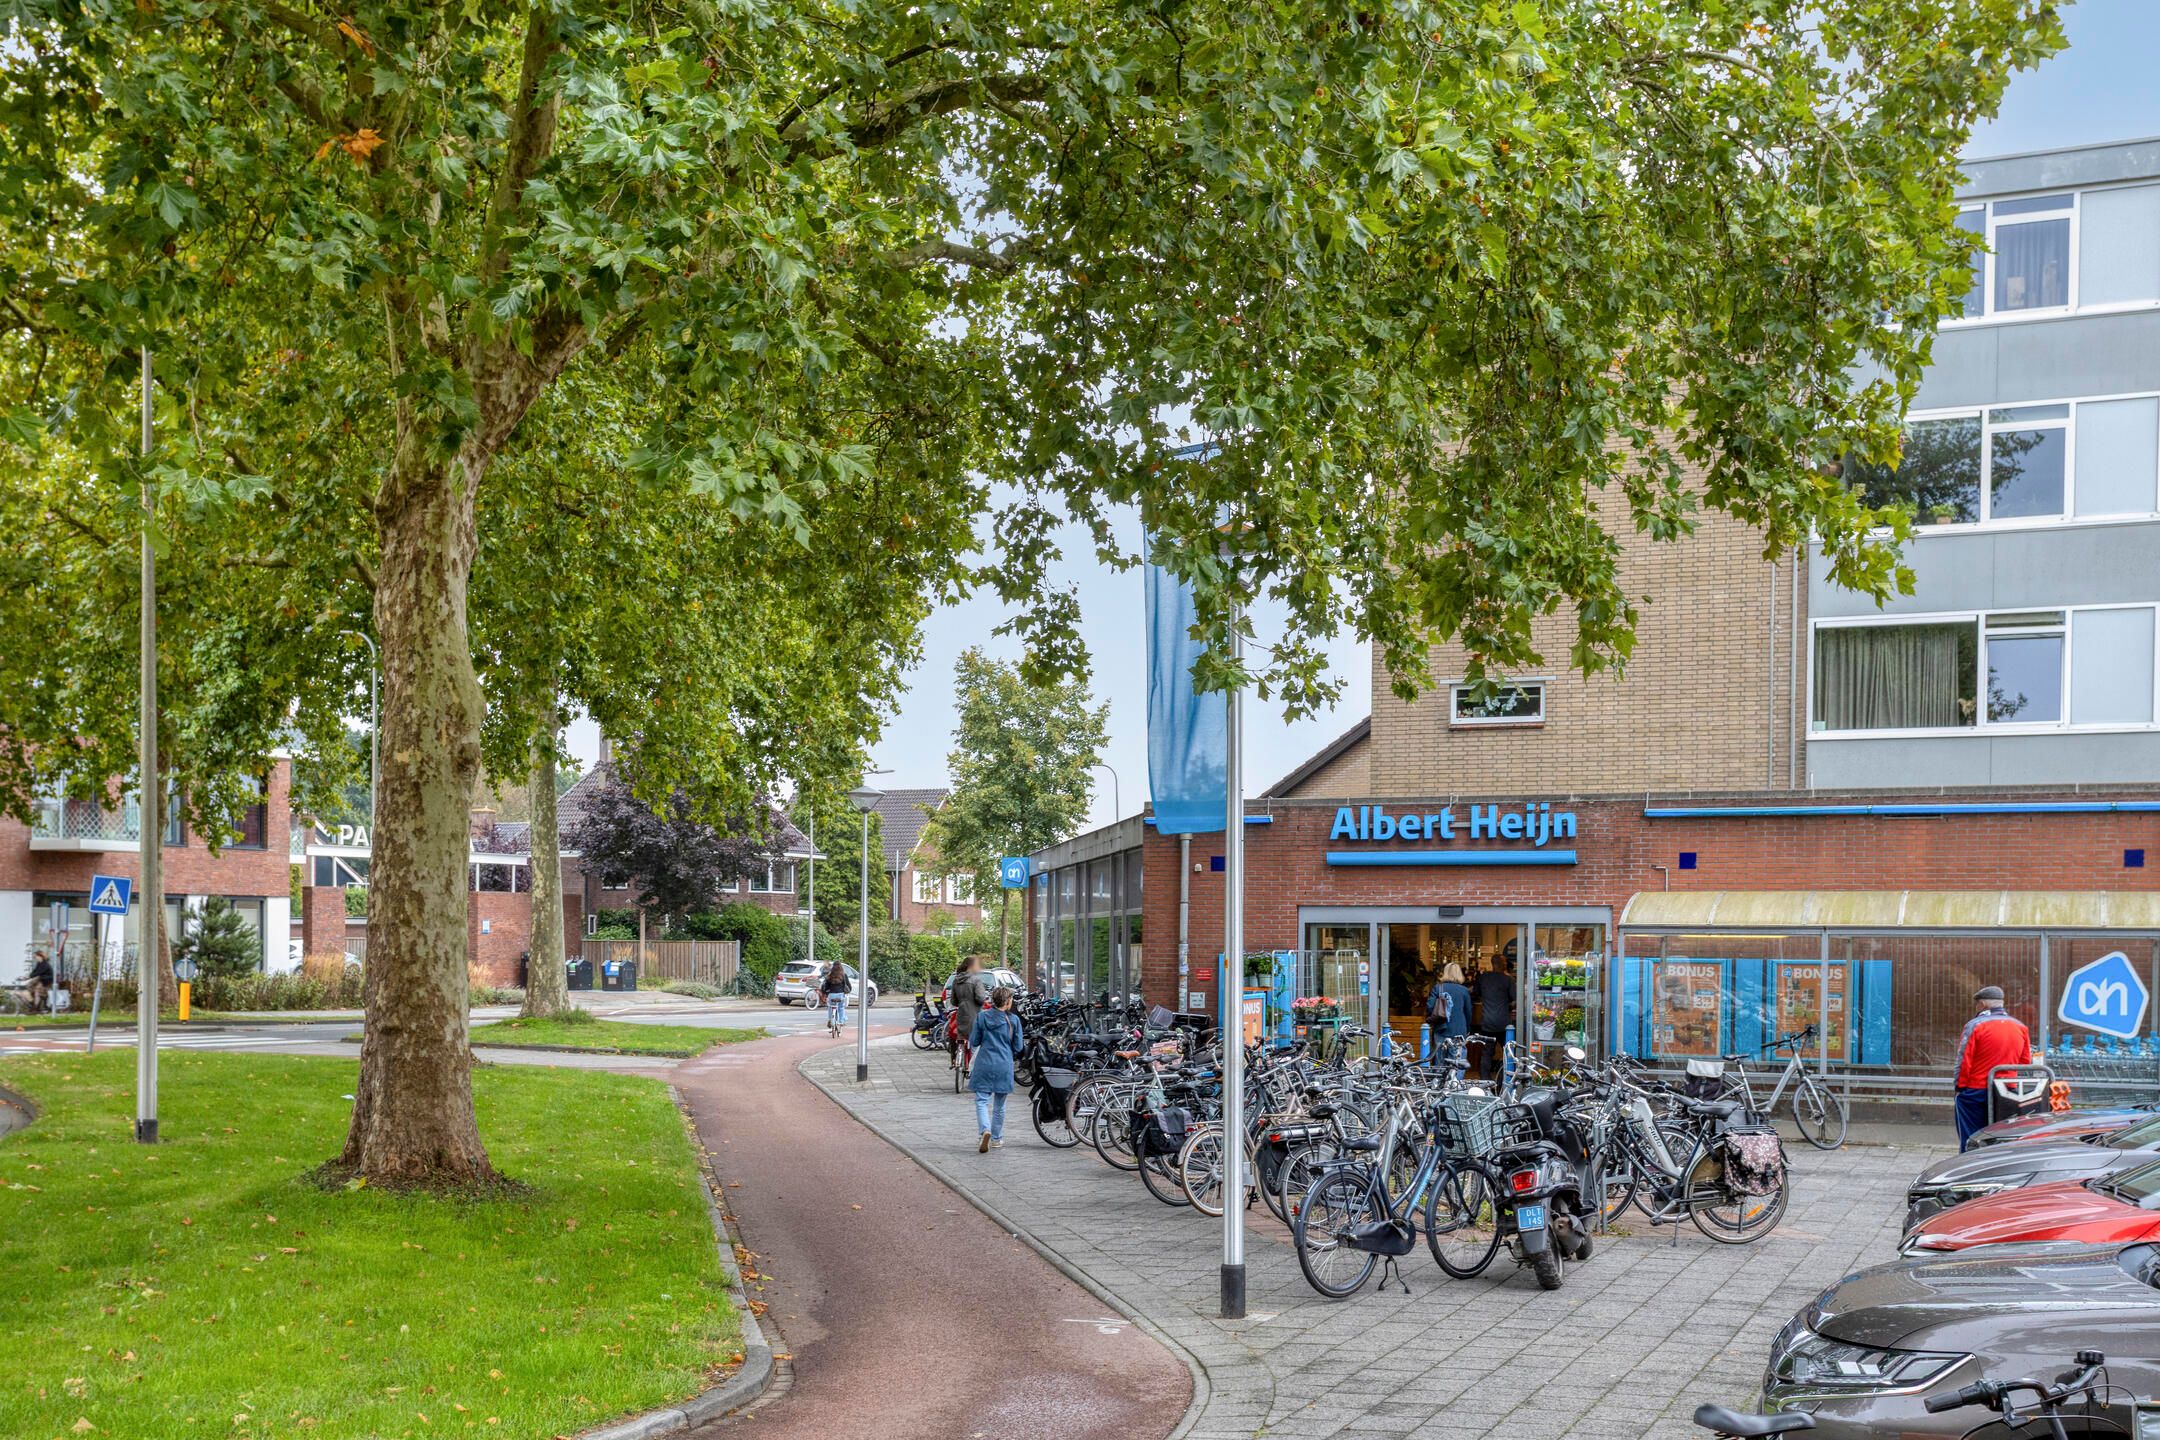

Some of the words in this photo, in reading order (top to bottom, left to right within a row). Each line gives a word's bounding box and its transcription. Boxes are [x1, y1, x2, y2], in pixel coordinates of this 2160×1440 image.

[1329, 805, 1455, 840] Albert
[1470, 802, 1577, 847] Heijn
[338, 824, 373, 847] PA
[1667, 964, 1715, 977] BONUS
[1242, 1001, 1261, 1015] NUS
